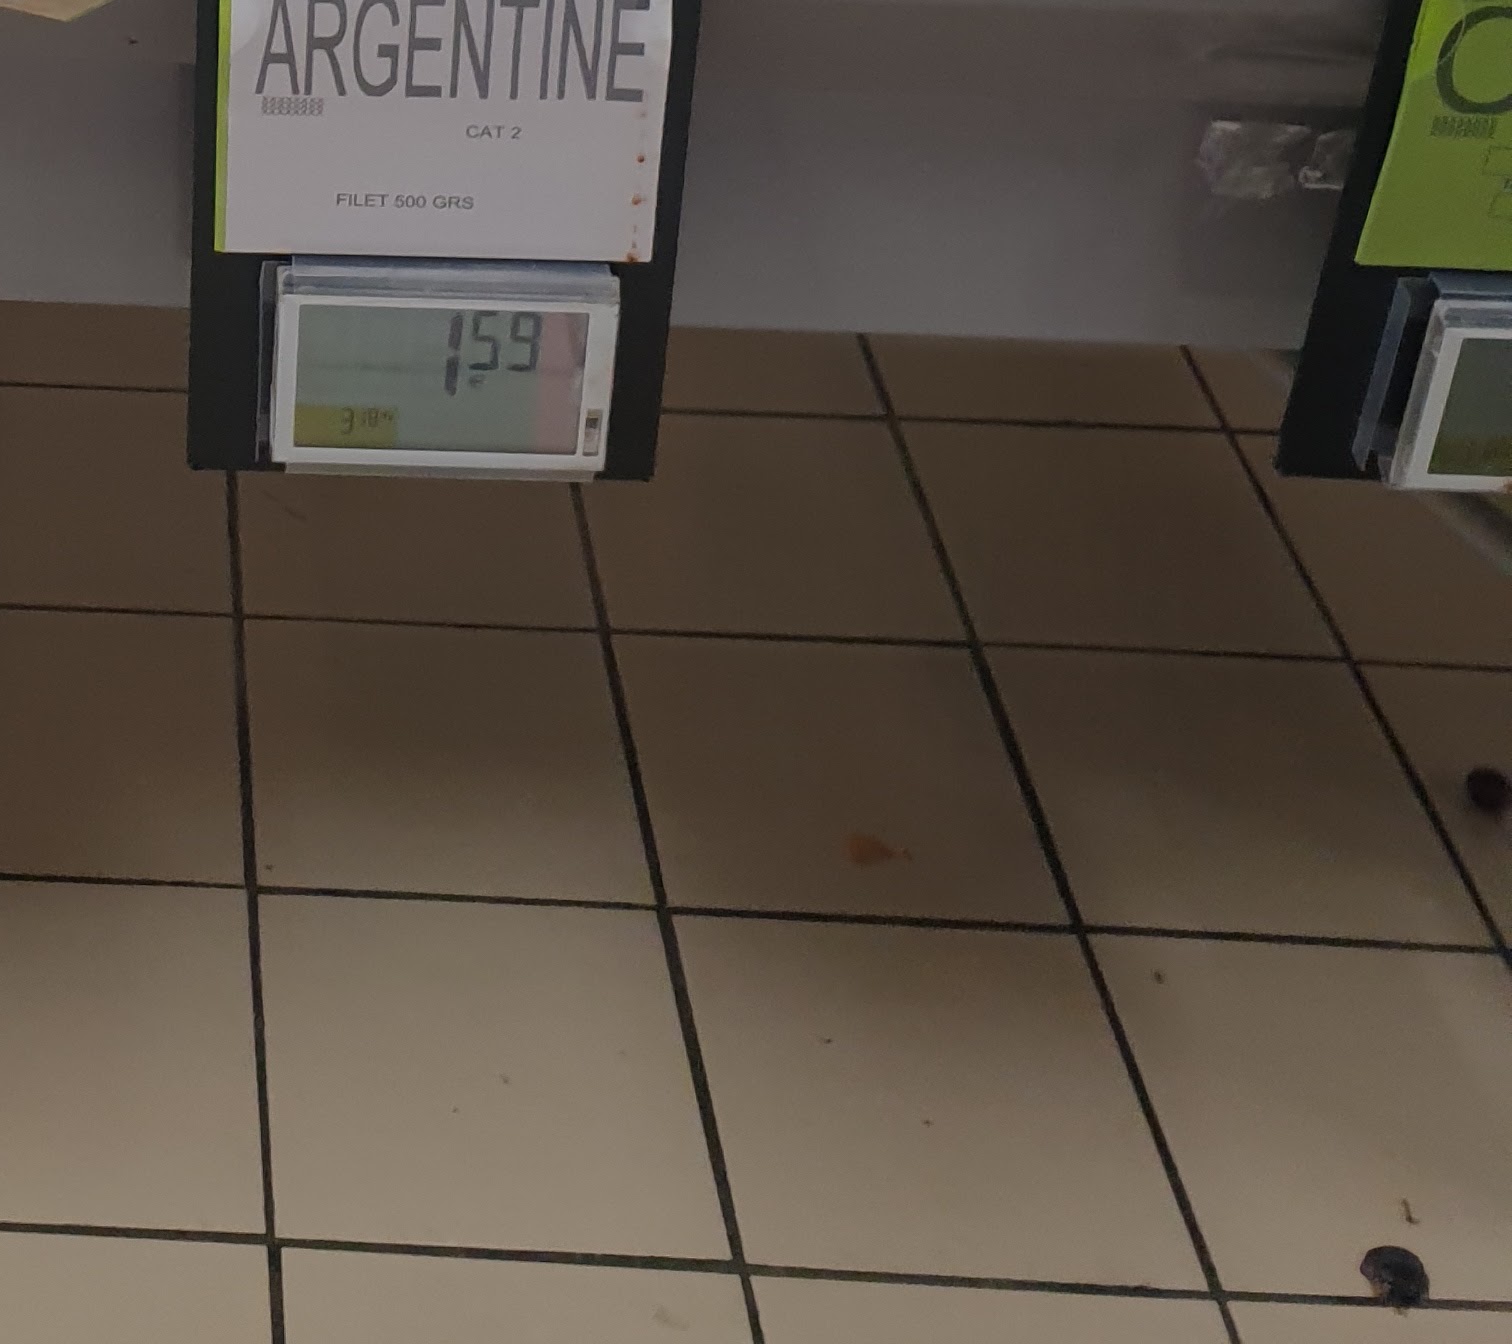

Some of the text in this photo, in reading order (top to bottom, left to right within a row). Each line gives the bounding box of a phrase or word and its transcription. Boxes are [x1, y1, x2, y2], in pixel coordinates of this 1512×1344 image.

[465, 124, 522, 140] CAT 2
[336, 193, 475, 210] FILET 500 GRS
